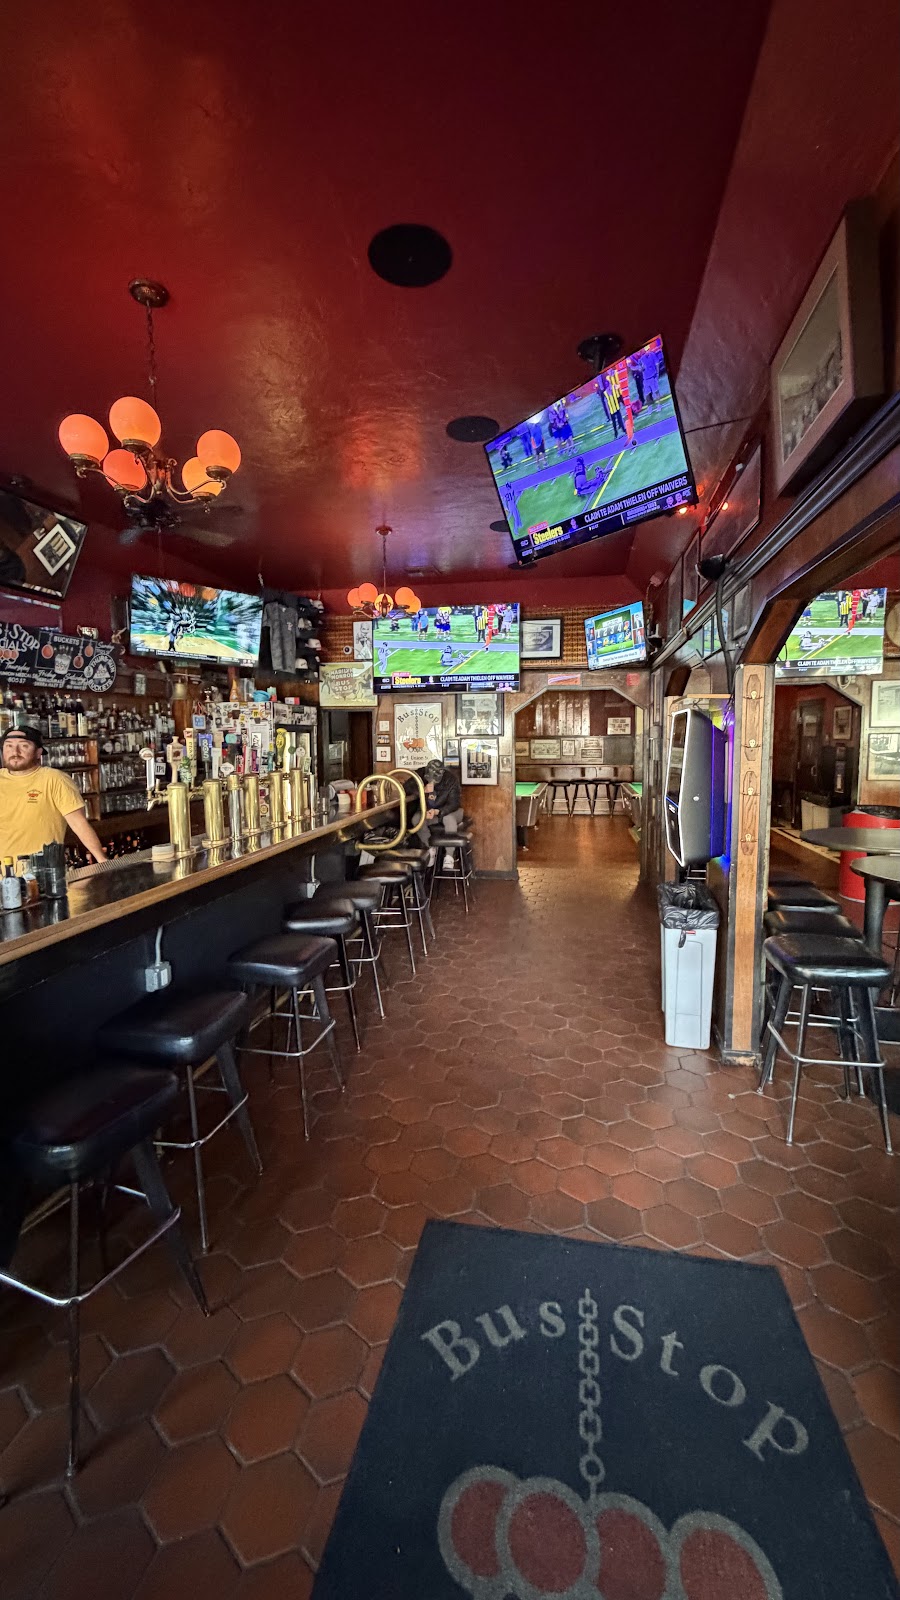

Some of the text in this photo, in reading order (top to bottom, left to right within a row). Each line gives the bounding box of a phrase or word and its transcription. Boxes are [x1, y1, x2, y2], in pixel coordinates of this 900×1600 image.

[607, 503, 624, 515] ADAM
[623, 494, 647, 510] THIELEN
[646, 487, 659, 499] OFF
[658, 476, 688, 494] WAIVERS
[533, 526, 564, 545] Steelers
[8, 623, 40, 651] STOP
[53, 635, 80, 646] BUCKETS
[88, 678, 113, 691] BUCKETS
[334, 684, 353, 692] STOP
[397, 708, 439, 723] Bus Stop
[421, 1299, 810, 1463] Bus Stop
